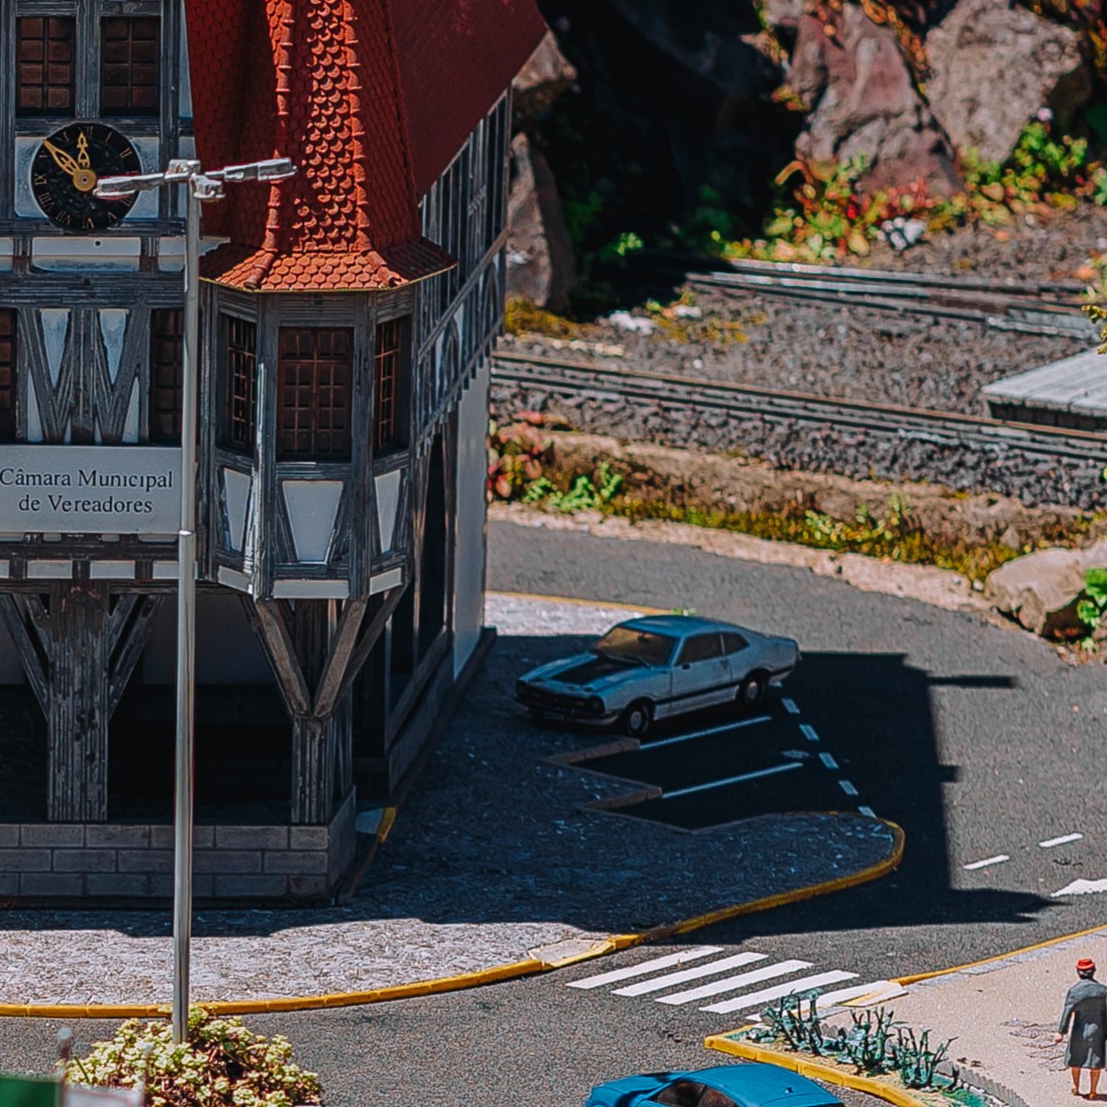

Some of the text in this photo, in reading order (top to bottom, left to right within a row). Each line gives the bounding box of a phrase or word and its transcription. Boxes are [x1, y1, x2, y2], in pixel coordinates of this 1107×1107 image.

[0, 467, 173, 493] Câmara Municipal
[18, 493, 153, 513] de Vereadores
